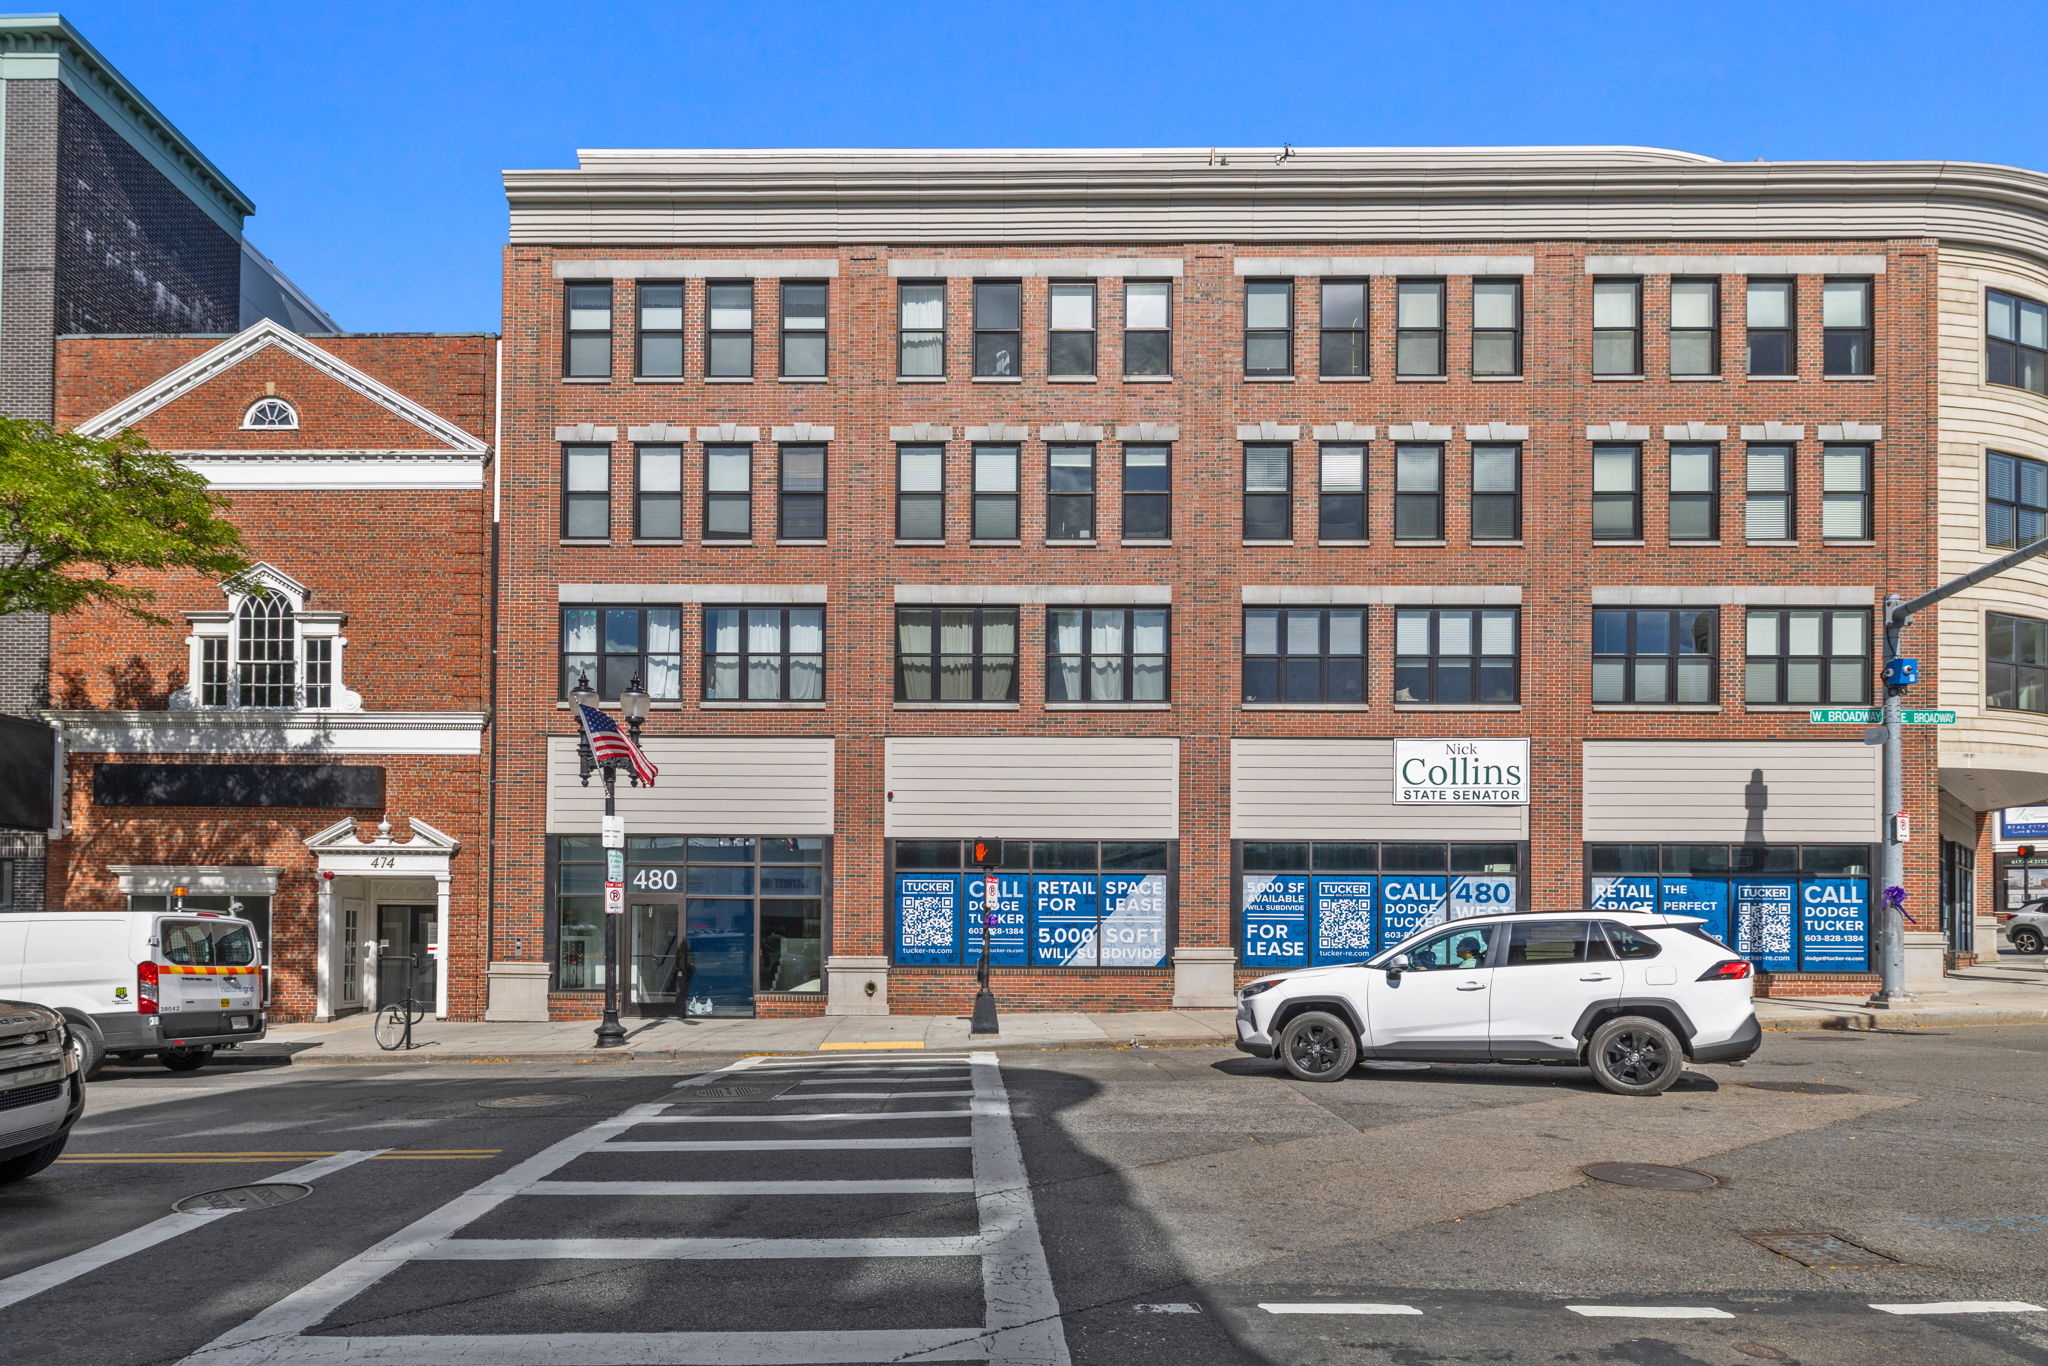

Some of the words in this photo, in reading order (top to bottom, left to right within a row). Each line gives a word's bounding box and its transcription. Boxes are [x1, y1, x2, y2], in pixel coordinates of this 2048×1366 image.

[1813, 711, 1824, 721] W.
[1828, 711, 1881, 722] BROADWAY
[1901, 714, 1909, 723] E.
[1914, 714, 1955, 723] BROADWAY
[1446, 743, 1478, 755] Nick
[1402, 757, 1521, 786] Collins
[1403, 790, 1447, 800] STATE
[1452, 790, 1520, 800] SENATOR
[371, 857, 395, 868] 474
[633, 869, 678, 890] 480
[906, 883, 950, 892] TUCKER
[968, 880, 1024, 898] CLL
[1038, 881, 1096, 895] RETAIL
[1105, 881, 1162, 895] SPACE
[1287, 882, 1305, 893] SF
[1322, 885, 1367, 894] TUCKER
[1384, 882, 1442, 900] CALL
[1455, 882, 1511, 904] 480
[1595, 884, 1654, 898] RETAIL
[1663, 885, 1688, 894] THE
[1741, 888, 1787, 898] TUCKER
[1247, 894, 1305, 903] AVAILABLE
[1804, 885, 1863, 904] CALL
[1038, 898, 1076, 911] FOR
[1105, 898, 1162, 911] LEASE
[1384, 903, 1438, 914] DODGE
[1663, 901, 1717, 911] PERFECT
[1804, 907, 1859, 918] DODGE
[968, 913, 1025, 924] TUKER
[1384, 916, 1442, 928] TUCKER
[1804, 920, 1864, 931] TUCKER
[1038, 927, 1094, 945] 5,000
[1106, 928, 1162, 943] SQFT
[1247, 924, 1288, 939] FOR
[1804, 934, 1864, 943] 603-828-1384
[1038, 947, 1072, 959] WILL
[1247, 941, 1304, 957] LEASE
